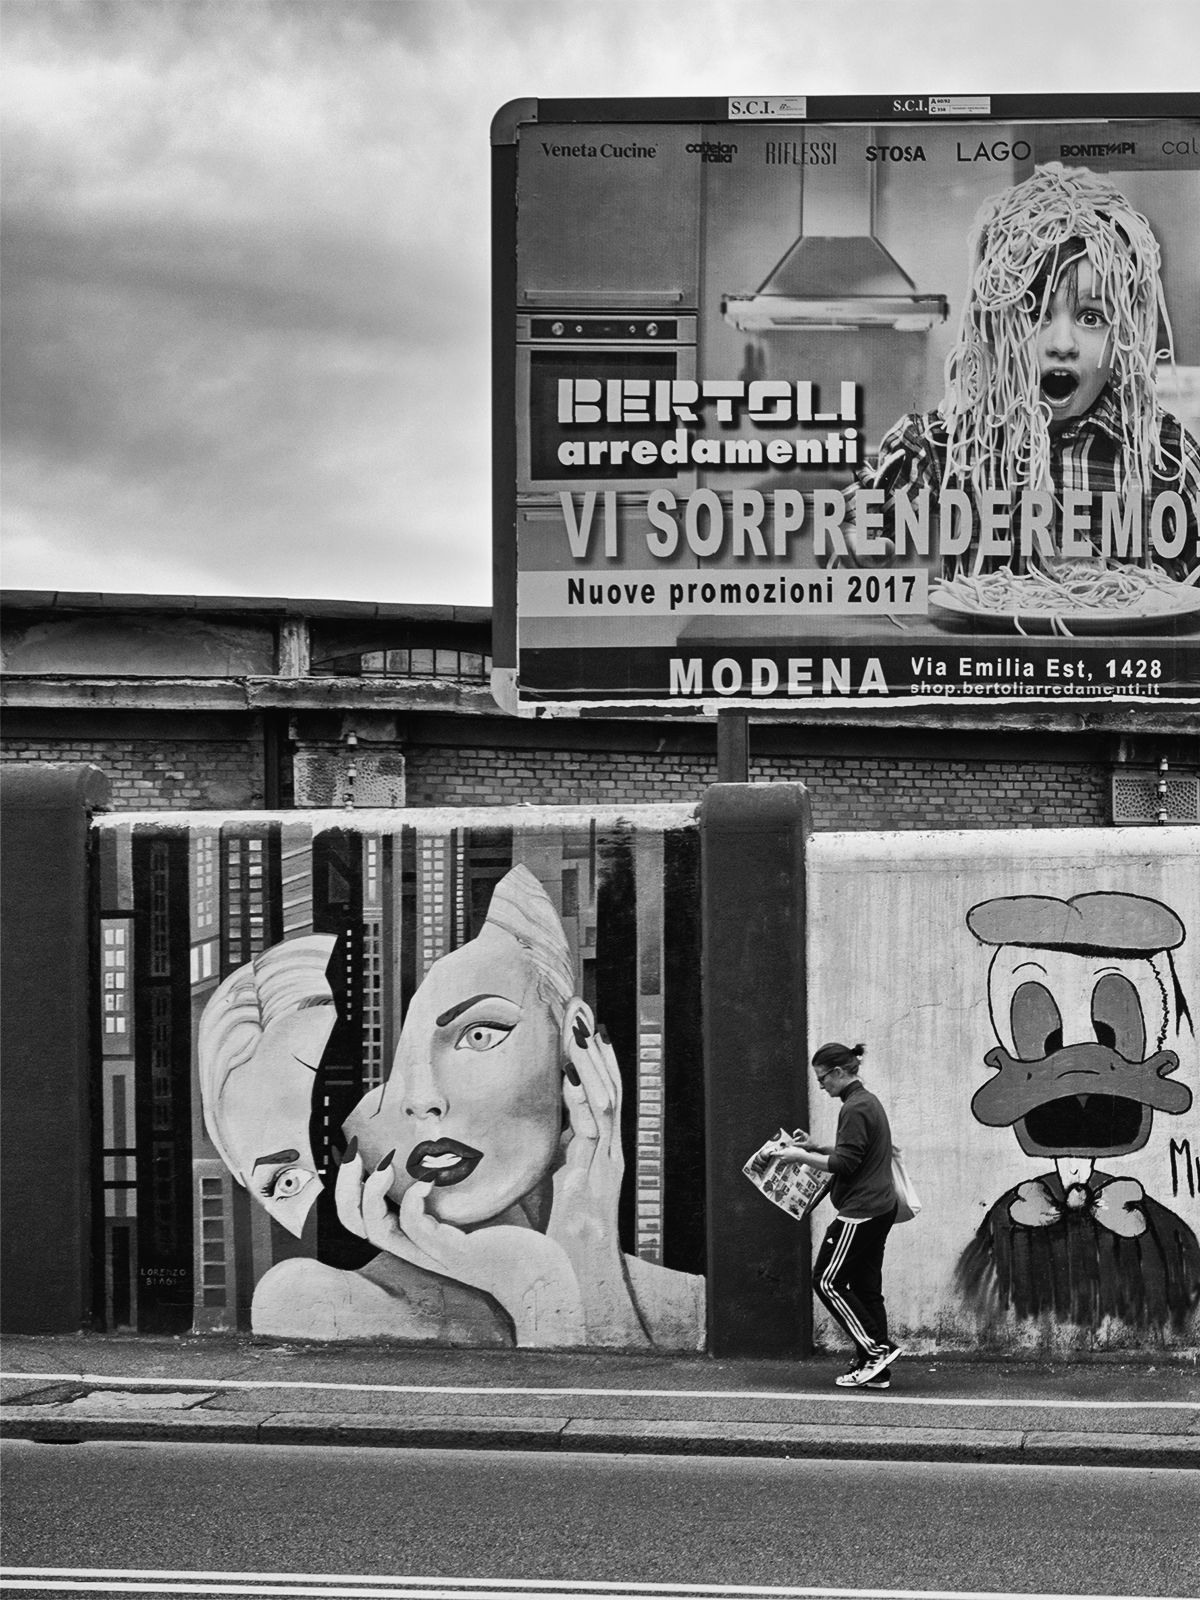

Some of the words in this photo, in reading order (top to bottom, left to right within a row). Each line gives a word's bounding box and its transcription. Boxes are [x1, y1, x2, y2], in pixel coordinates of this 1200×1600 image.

[541, 142, 597, 158] Veneta
[600, 142, 657, 159] Cucine
[765, 142, 837, 165] RIFLESSI
[865, 146, 926, 162] STOSA
[956, 140, 1031, 162] LAGO
[1060, 142, 1136, 157] BONTEMPI
[558, 379, 857, 423] BERTOLI
[557, 428, 858, 466] arredamenti
[558, 491, 618, 558] VI
[567, 578, 655, 605] Nuove
[669, 577, 833, 611] promozioni
[847, 576, 916, 604] 2017
[669, 657, 889, 695] MODENA
[911, 656, 947, 677] Via
[959, 657, 1034, 678] Emilia
[1047, 658, 1093, 681] Est,
[1106, 659, 1162, 679] 1428
